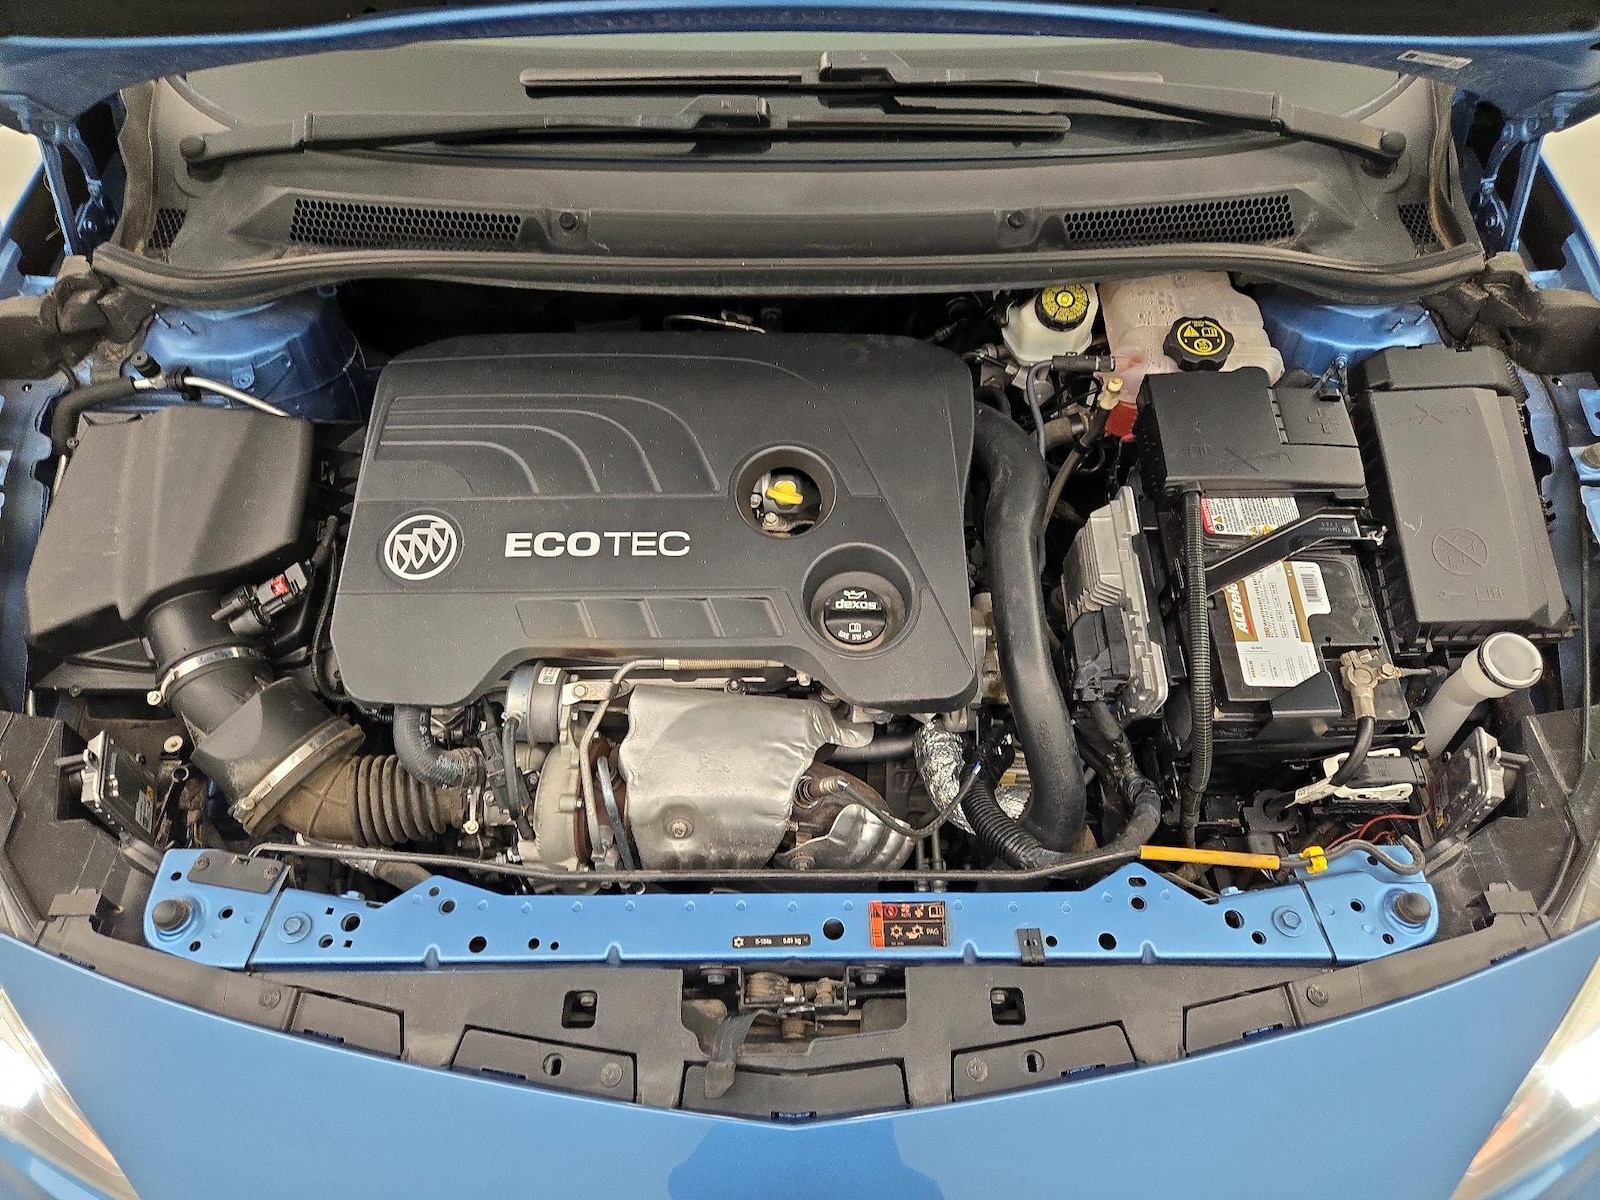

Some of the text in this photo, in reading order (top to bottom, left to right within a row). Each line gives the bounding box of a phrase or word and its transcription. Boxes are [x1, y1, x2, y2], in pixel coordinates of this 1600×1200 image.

[504, 531, 691, 558] ECOTEC
[835, 598, 877, 610] dexos
[1226, 583, 1249, 634] ACDelc
